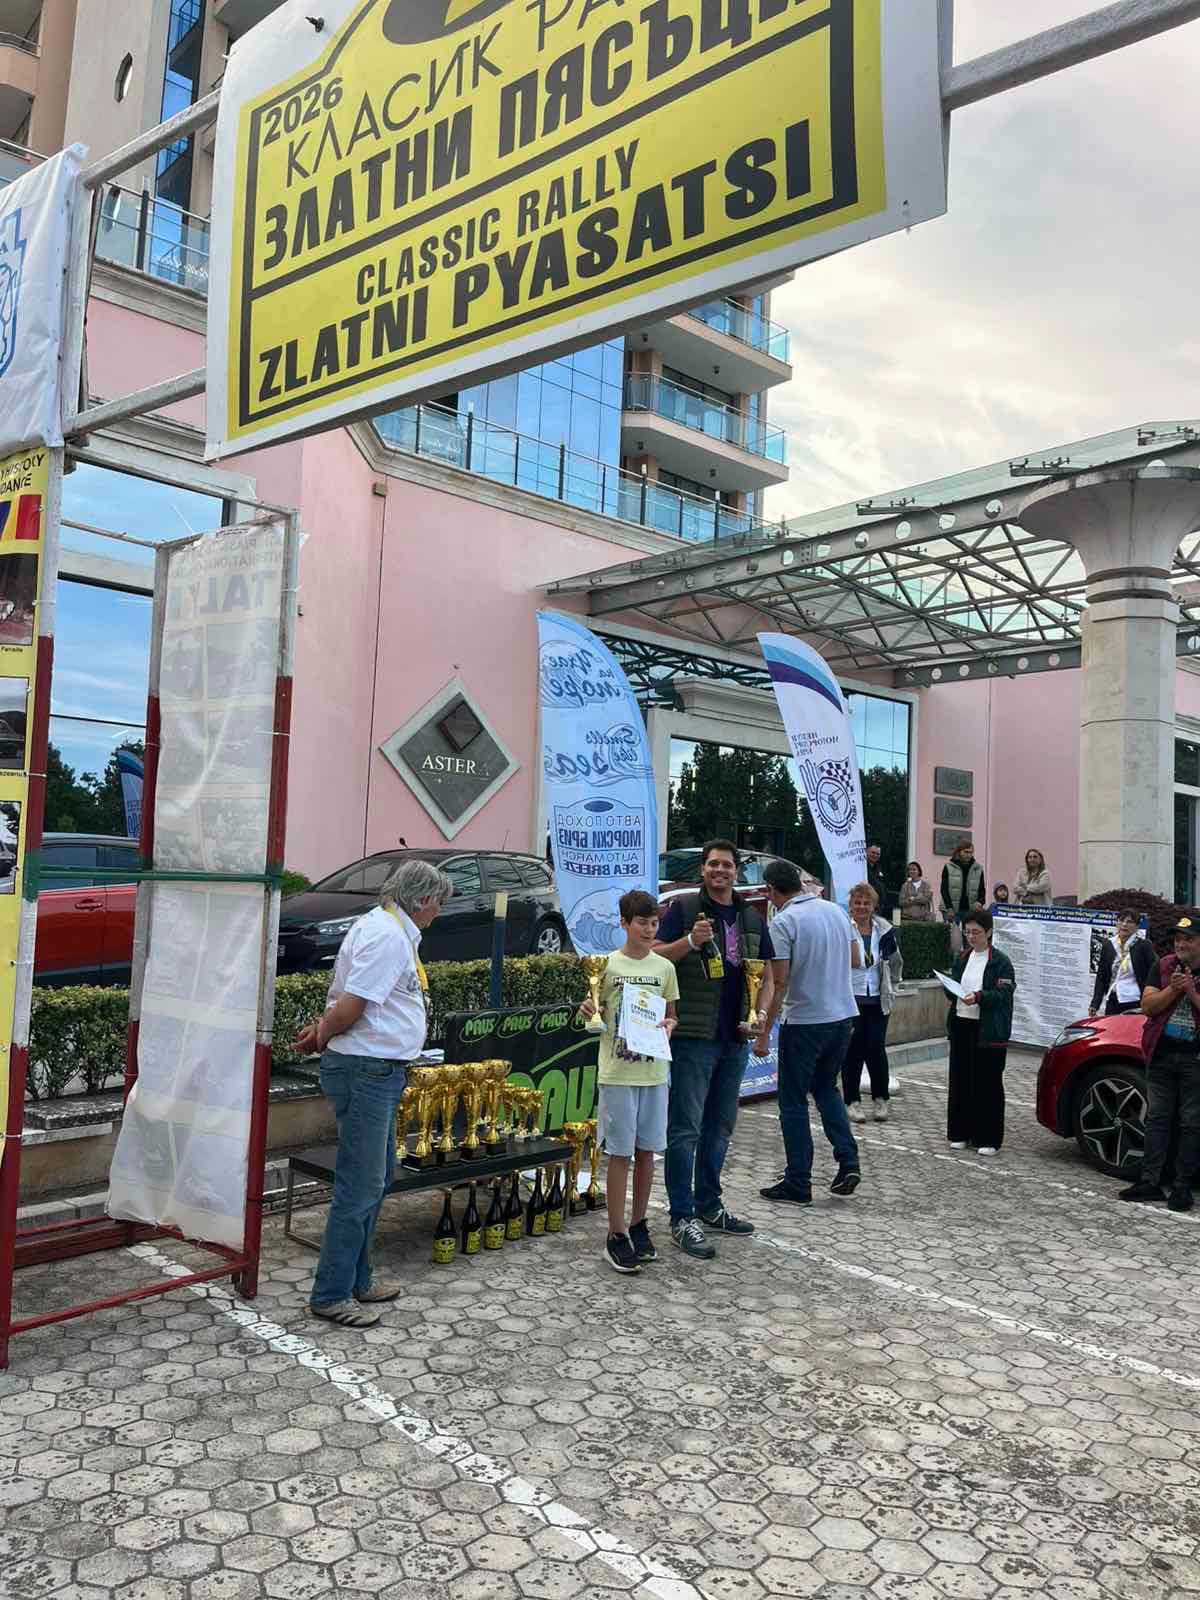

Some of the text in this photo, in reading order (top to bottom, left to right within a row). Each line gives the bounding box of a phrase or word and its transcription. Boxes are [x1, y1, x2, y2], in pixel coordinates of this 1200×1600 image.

[263, 77, 343, 147] 2026
[286, 22, 503, 188] КЛАСИК
[259, 118, 812, 402] ZLATNI PYASATSI
[263, 105, 473, 272] ЗЛАТНИ
[357, 139, 640, 305] CLASSIC RALLY
[422, 754, 476, 774] ASTER
[464, 1018, 497, 1037] PAUS
[502, 1014, 534, 1033] PAUS
[541, 1012, 569, 1030] PAUS
